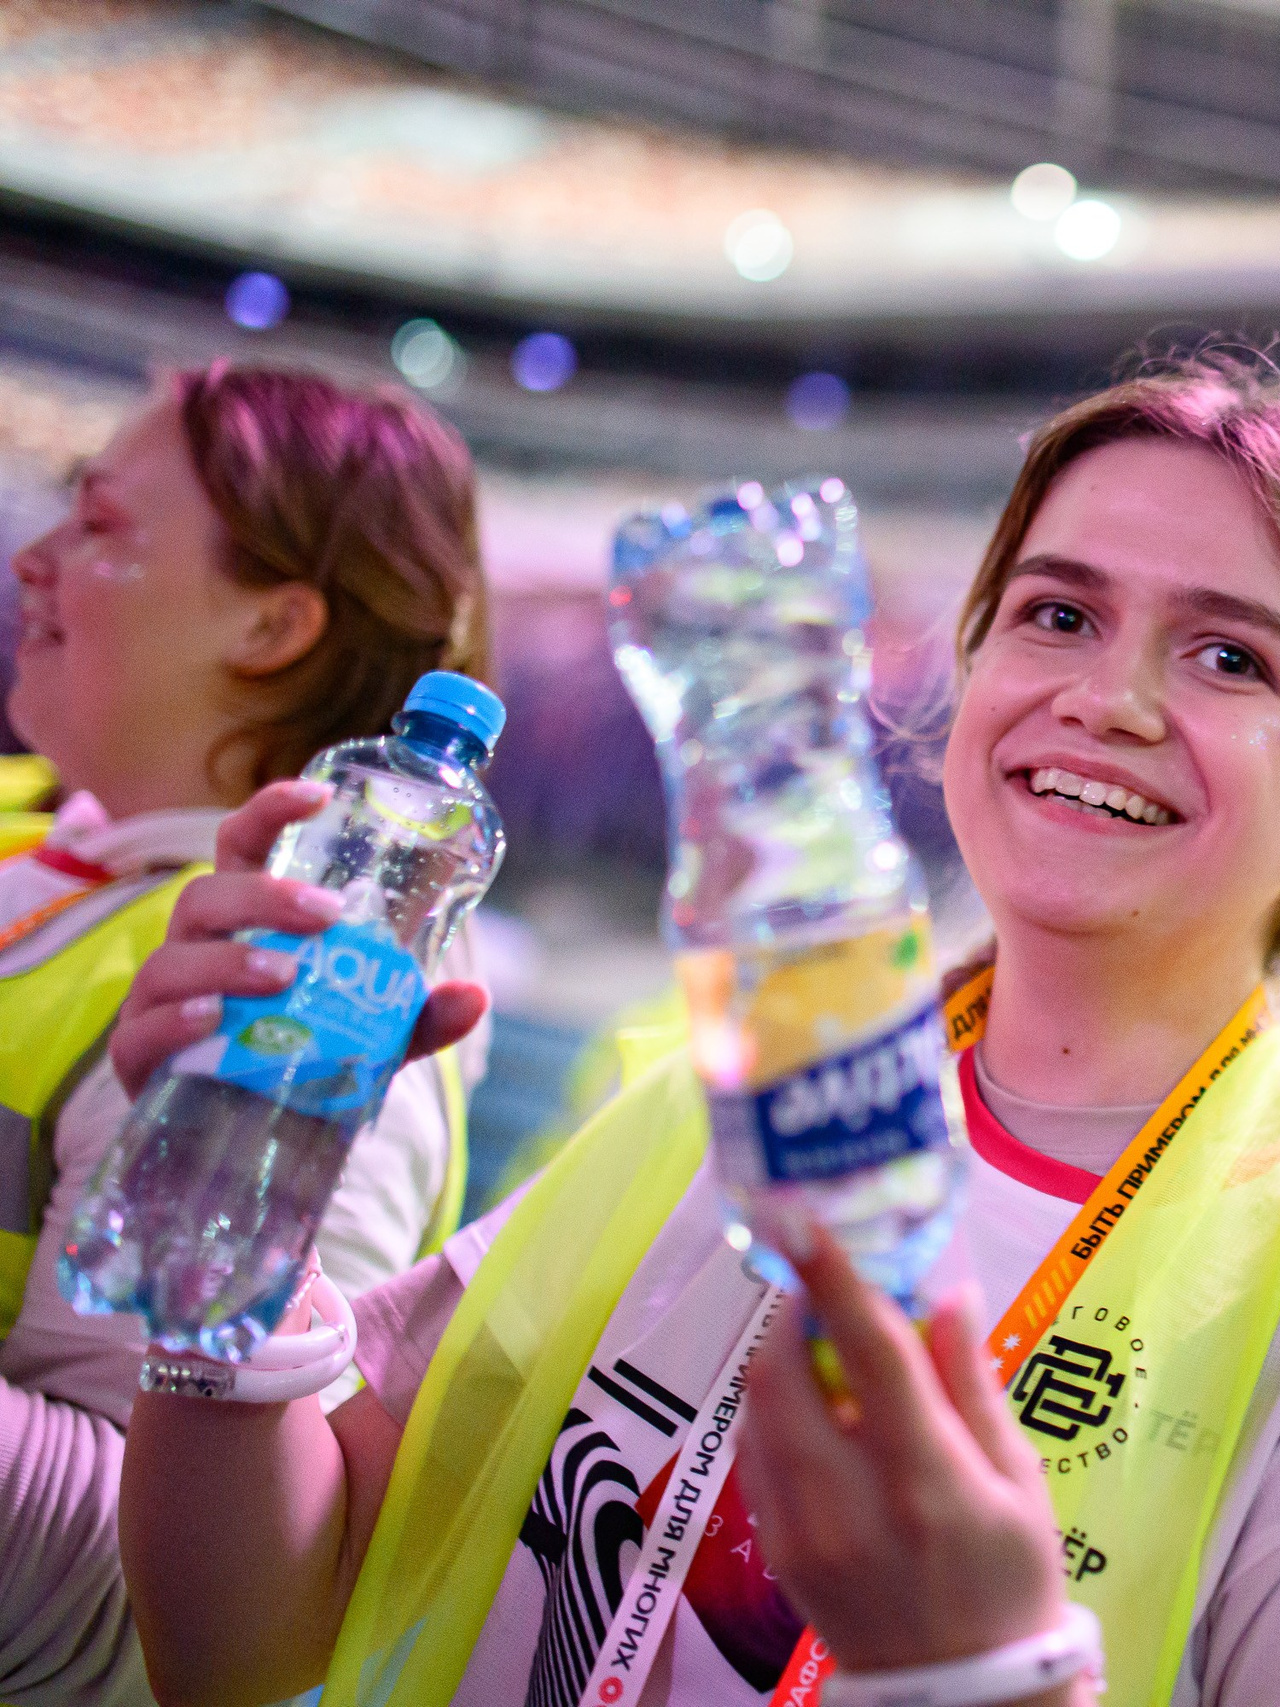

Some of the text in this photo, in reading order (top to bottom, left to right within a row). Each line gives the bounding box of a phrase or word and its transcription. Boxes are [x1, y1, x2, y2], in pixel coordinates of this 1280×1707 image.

[297, 938, 416, 1020] AQUA
[1070, 1202, 1125, 1260] БЫТЬ
[663, 1478, 702, 1541] ДЛЯ
[610, 1546, 676, 1672] МНОГИХ
